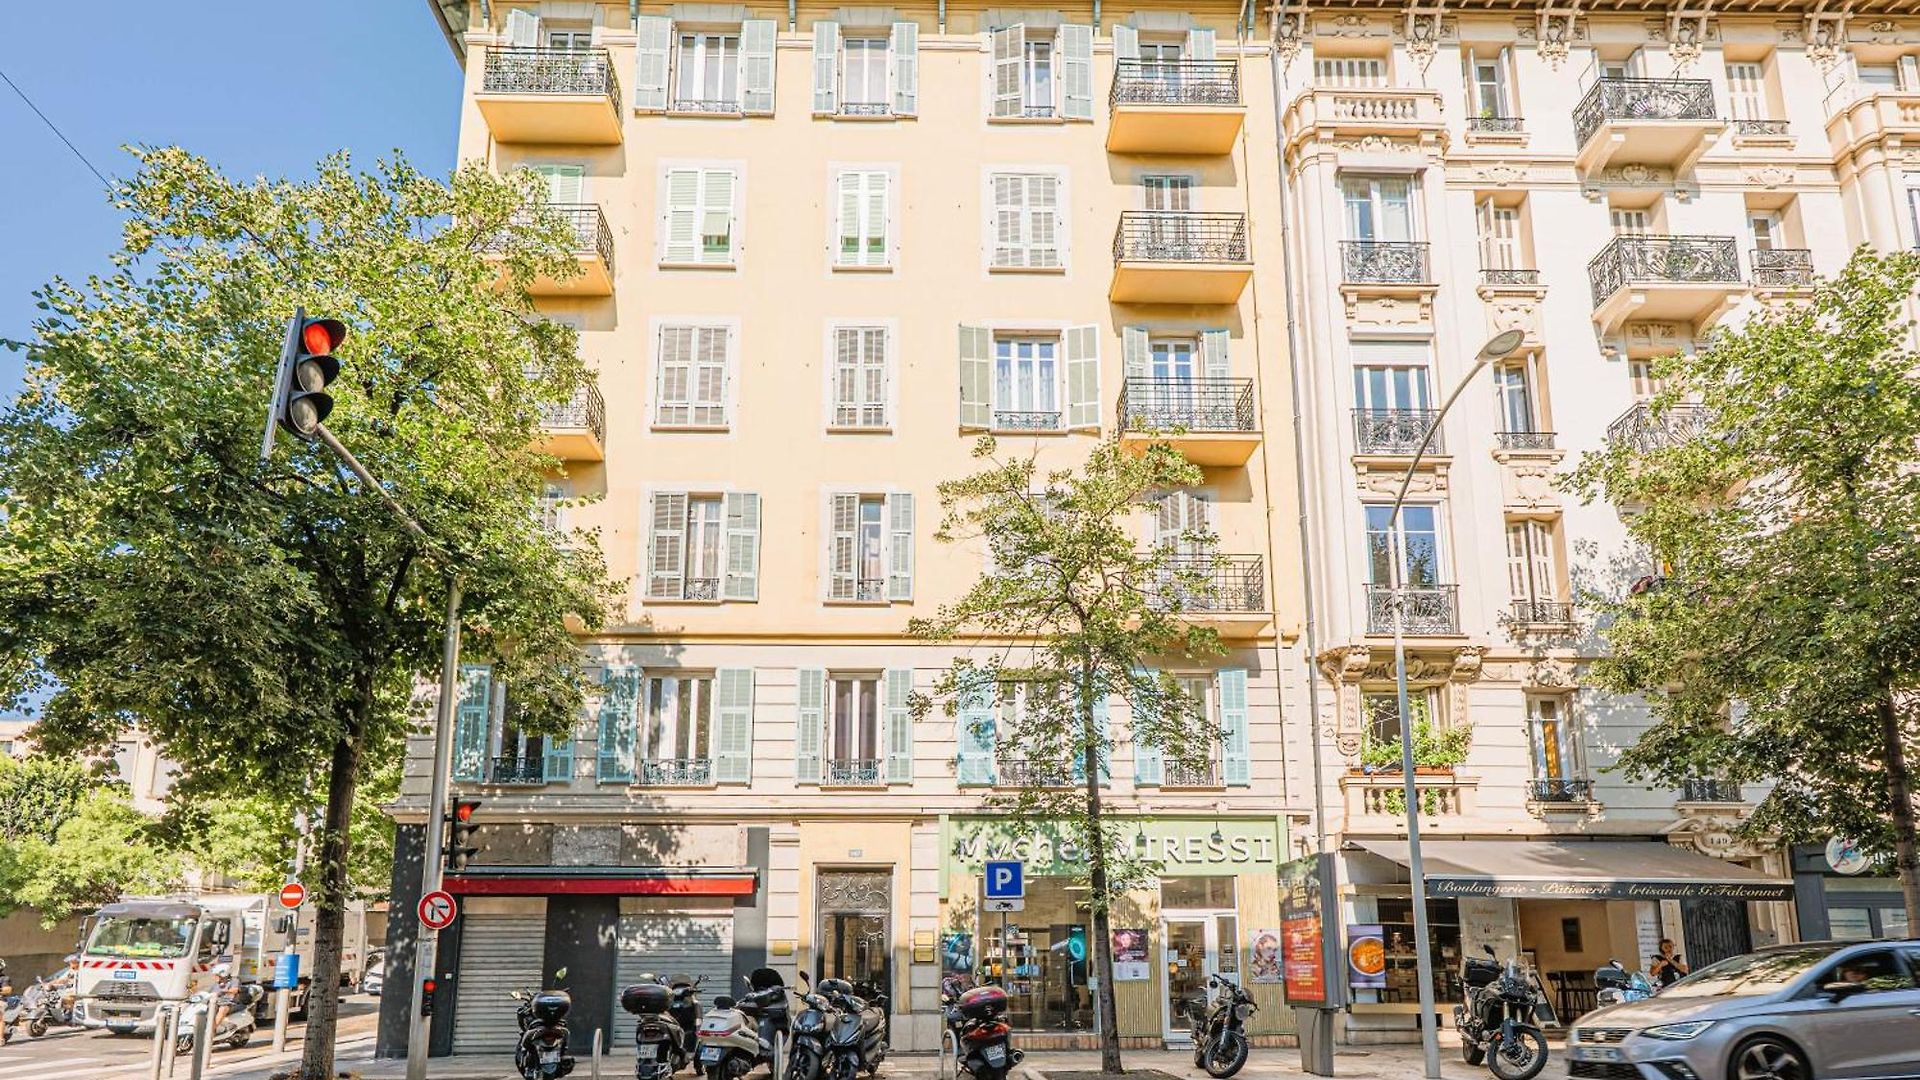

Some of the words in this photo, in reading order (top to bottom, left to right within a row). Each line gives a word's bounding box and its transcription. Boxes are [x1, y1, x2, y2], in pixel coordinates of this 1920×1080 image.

[996, 868, 1012, 890] P
[1437, 880, 1527, 897] Boulangerie
[1628, 883, 1694, 896] Artisanale
